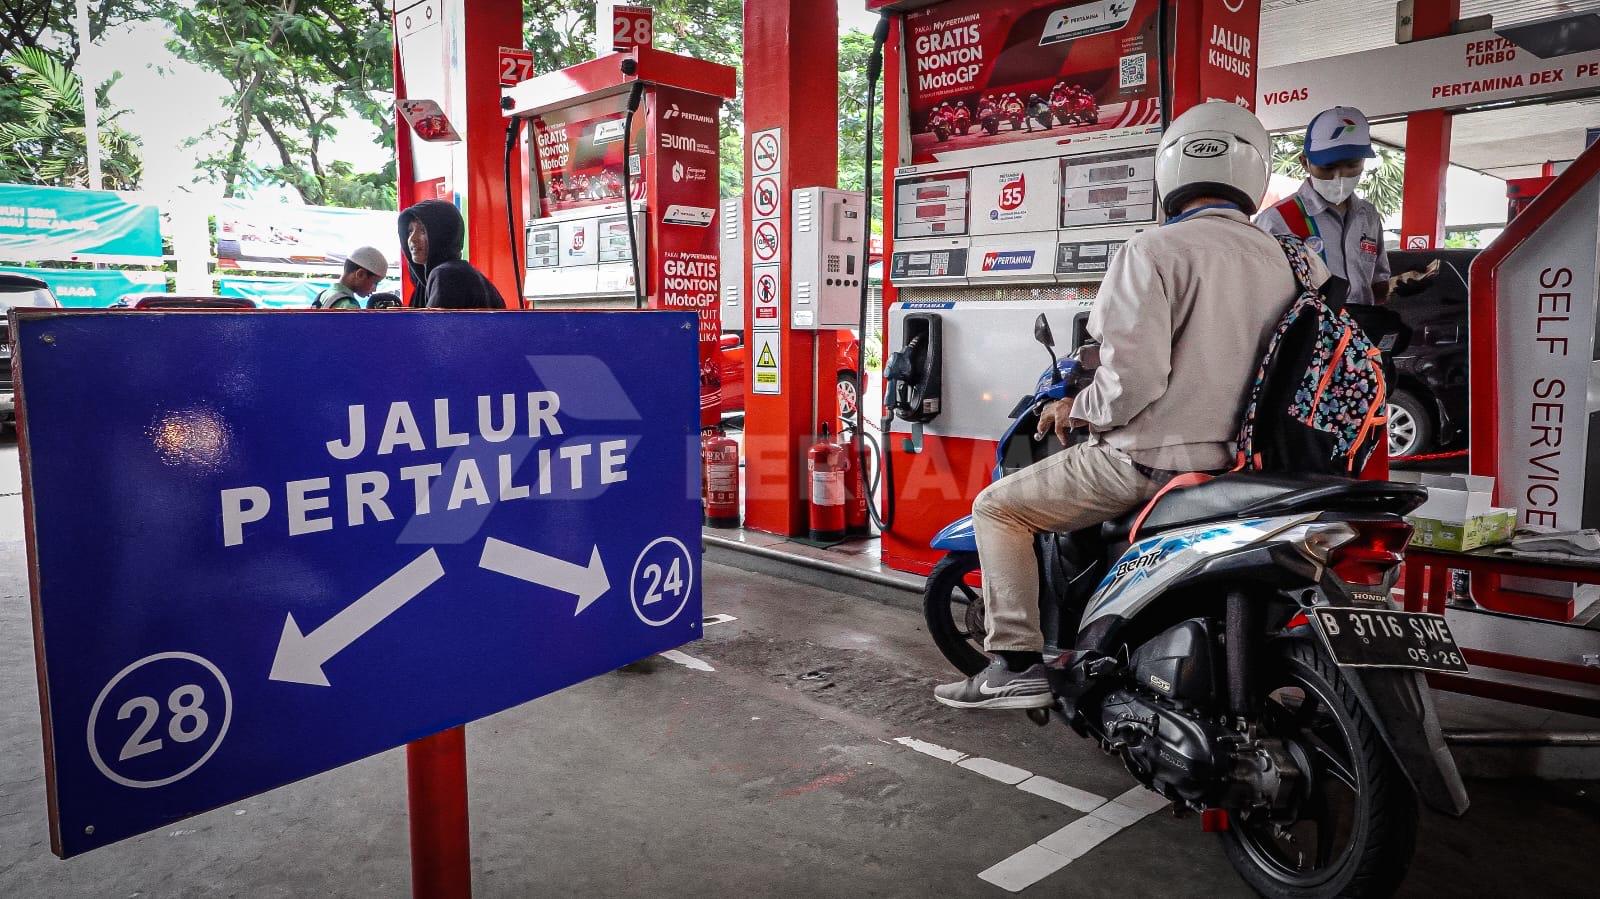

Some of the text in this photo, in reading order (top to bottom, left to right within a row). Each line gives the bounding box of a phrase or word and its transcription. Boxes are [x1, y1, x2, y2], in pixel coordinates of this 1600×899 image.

[614, 17, 651, 44] 28
[916, 24, 980, 55] GRATIS
[1210, 24, 1251, 59] JALUR
[917, 45, 983, 72] NONTON
[1466, 37, 1518, 55] PERTA
[1466, 49, 1516, 68] TURBO
[501, 57, 532, 82] 27
[1208, 48, 1251, 78] KHUSUS
[918, 64, 980, 91] MotoGP
[1431, 74, 1524, 99] PERTAMINA
[1529, 69, 1564, 86] DEX
[1263, 87, 1309, 106] VIGAS
[681, 112, 714, 124] PERTAMINA
[538, 128, 567, 146] GRATIS
[540, 143, 569, 158] NONTON
[541, 155, 569, 170] MotoGP
[664, 260, 717, 278] GRATIS
[984, 255, 1032, 269] MyPERTAMINA
[664, 278, 718, 292] NONTON
[664, 292, 715, 307] MotoGP
[1525, 267, 1573, 529] SELF SERVICE
[326, 390, 564, 460] JALUR
[221, 439, 629, 548] PERTALITE
[643, 557, 683, 606] 24
[1353, 593, 1386, 602] HONDA
[1321, 612, 1452, 643] B 3716 SWE
[116, 683, 210, 763] 28
